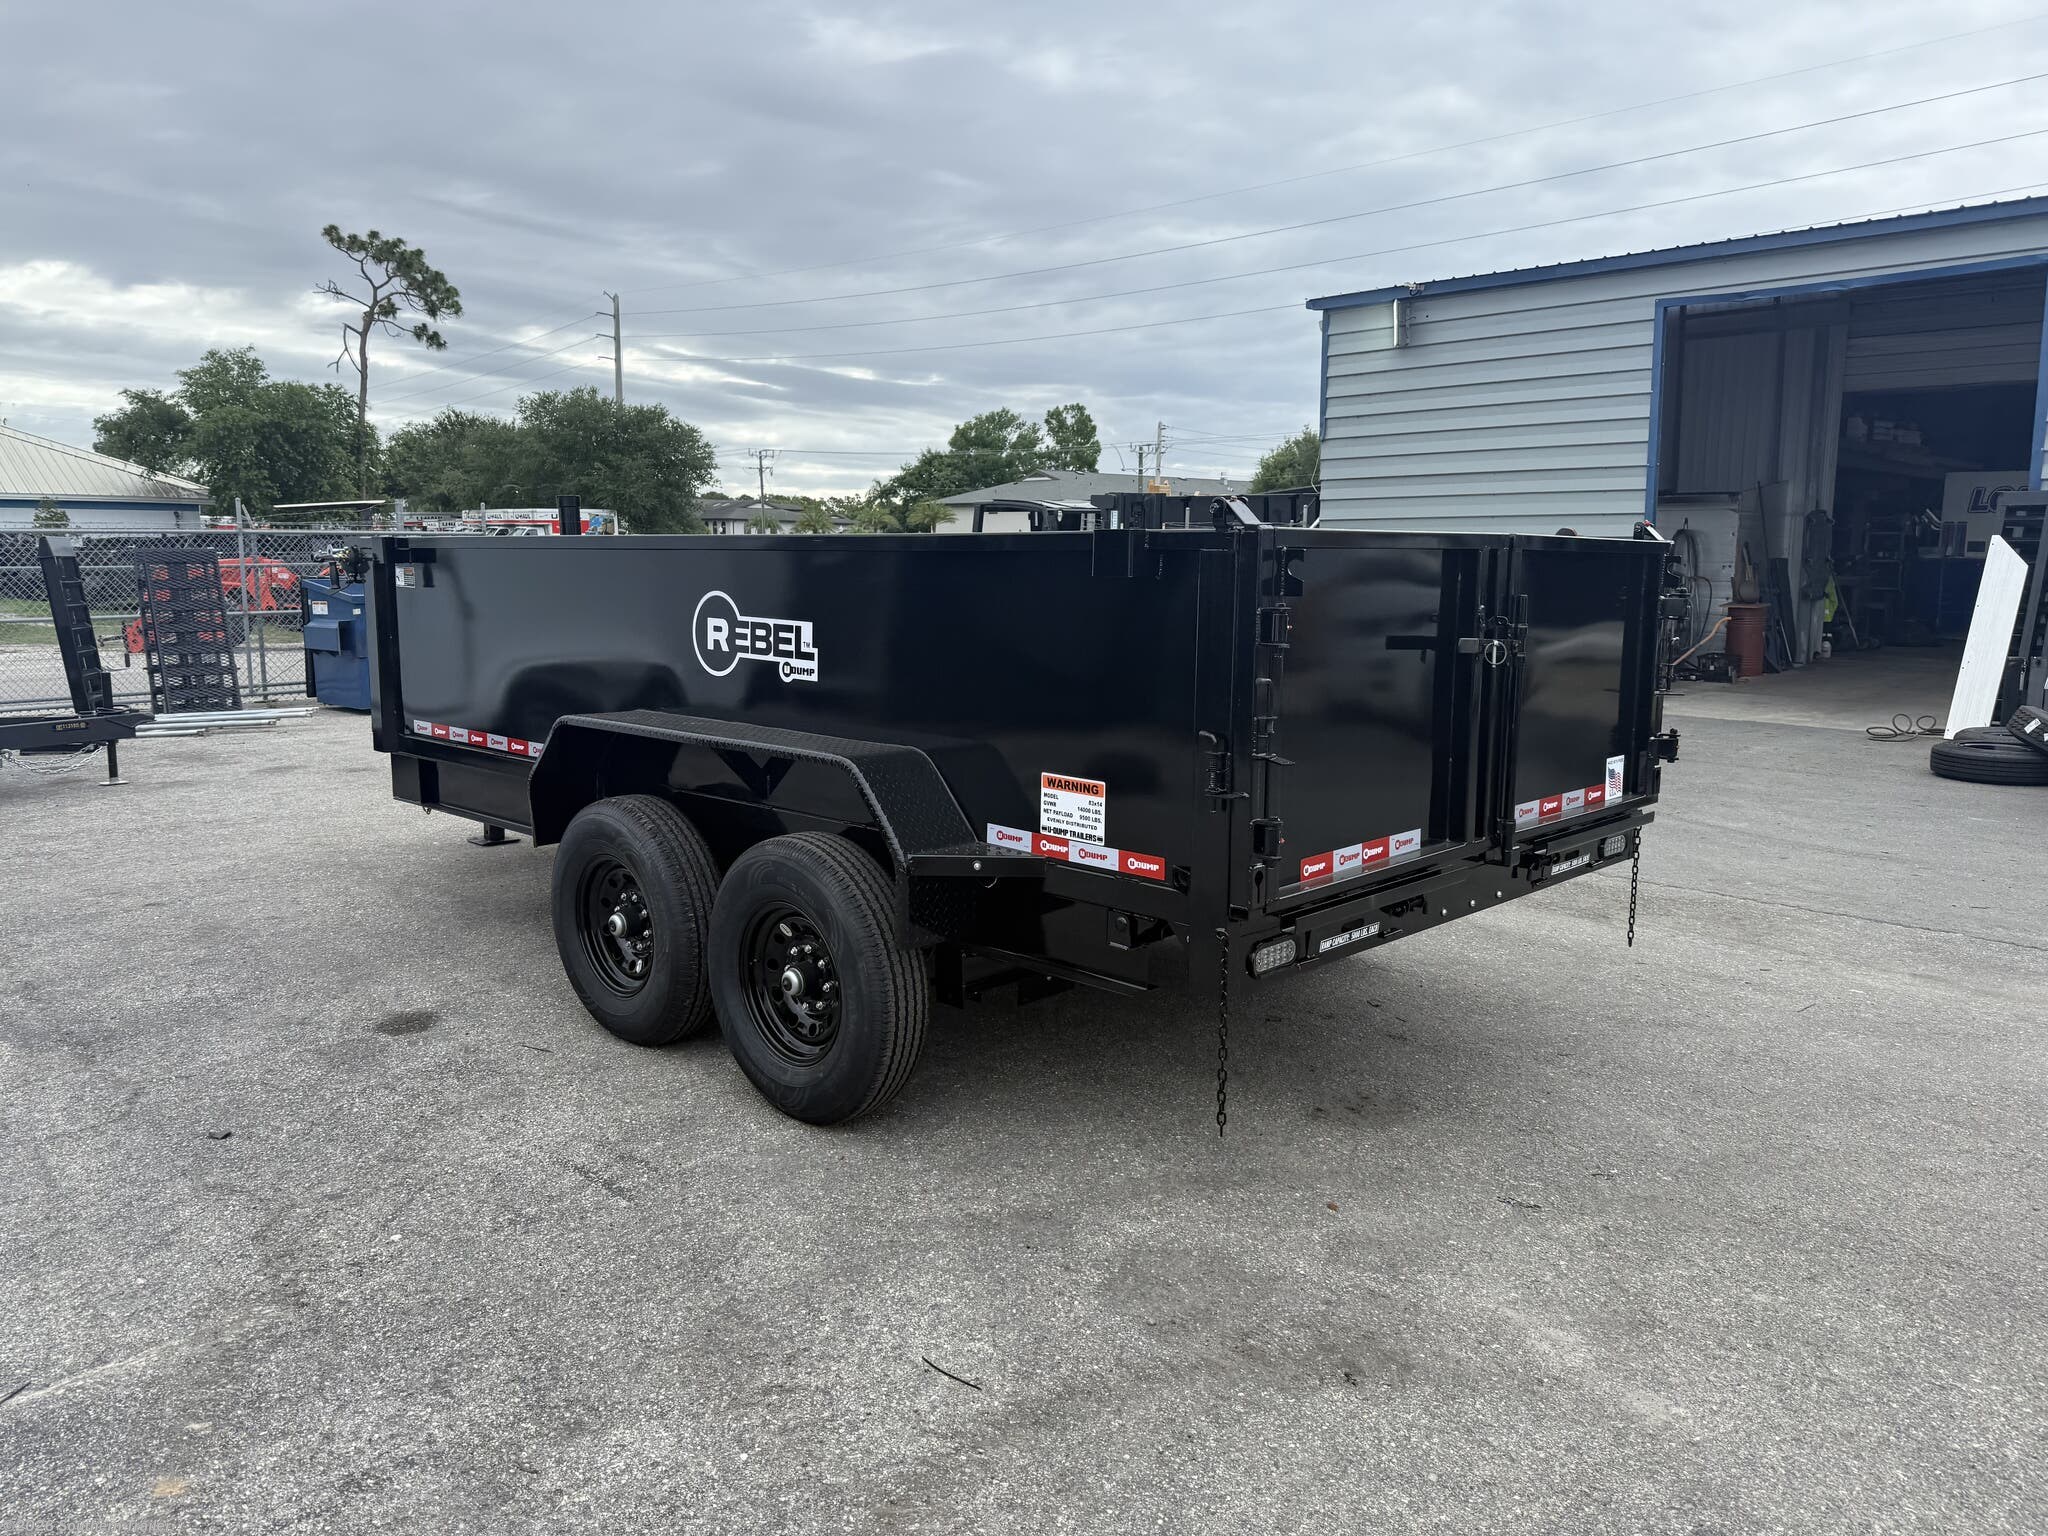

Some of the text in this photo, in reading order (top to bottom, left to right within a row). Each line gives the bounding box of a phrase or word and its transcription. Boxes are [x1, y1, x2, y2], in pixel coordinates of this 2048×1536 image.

[707, 617, 815, 661] REBEL
[1047, 777, 1099, 795] WARNING
[1054, 809, 1073, 817] PAYLOAD
[1077, 806, 1091, 814] 14000
[1047, 817, 1097, 830] EVENLY DISTRIBUTED
[1047, 825, 1097, 842] U-DUMP TRAILERS
